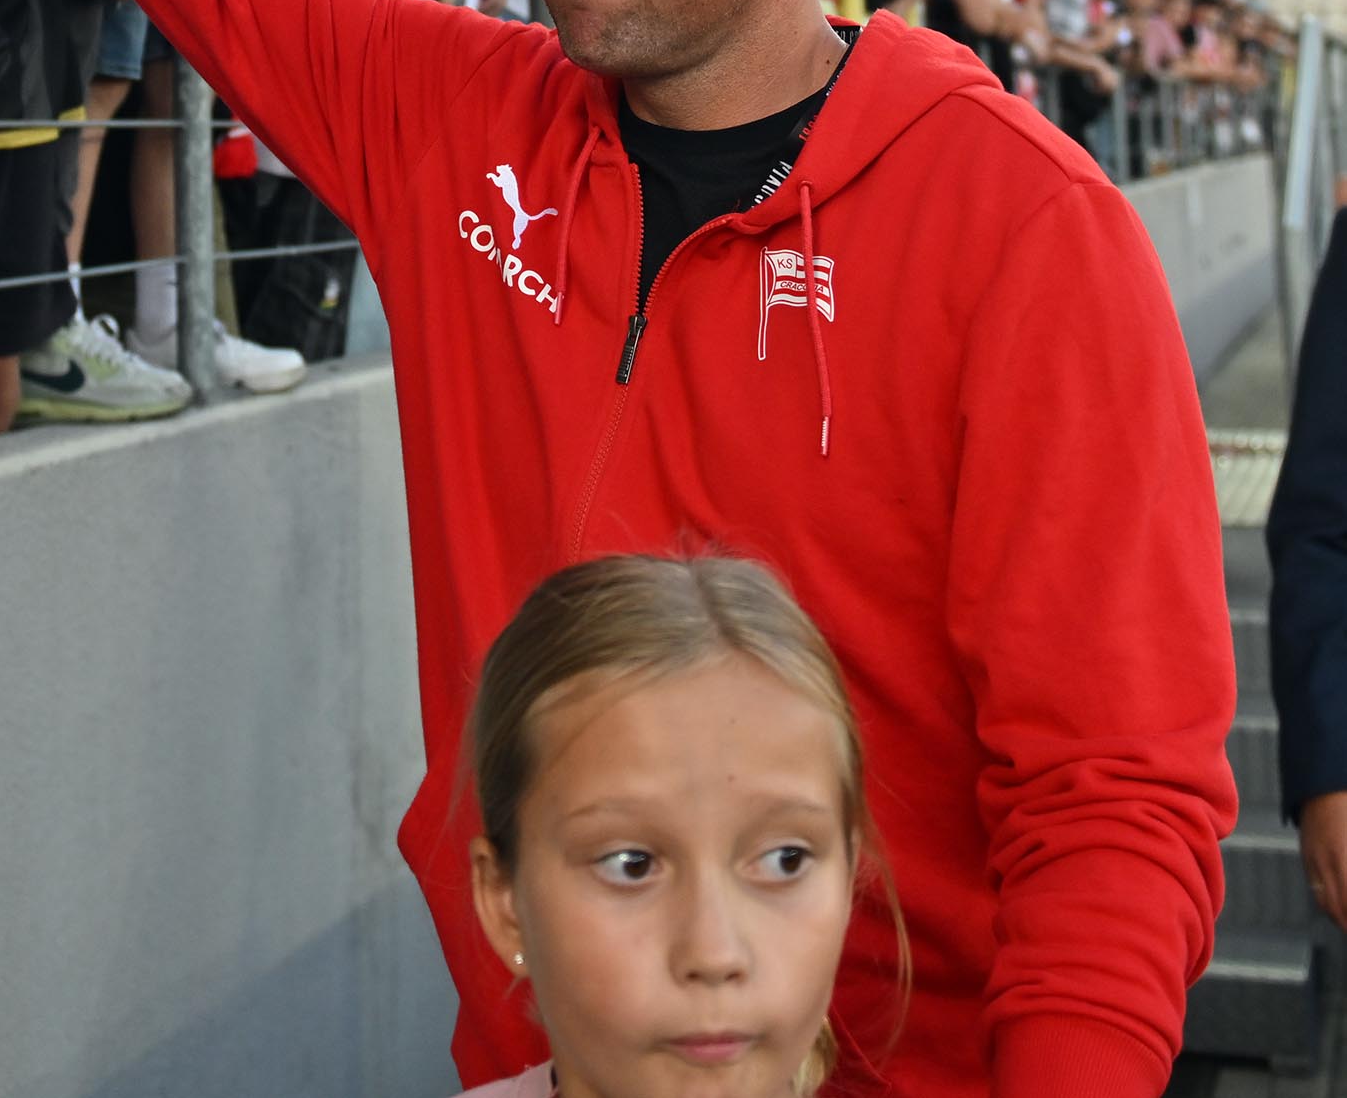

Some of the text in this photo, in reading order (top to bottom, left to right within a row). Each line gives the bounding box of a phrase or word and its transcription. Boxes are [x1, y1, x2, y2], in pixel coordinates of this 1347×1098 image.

[458, 210, 559, 314] CORCH
[777, 258, 794, 270] KS
[780, 281, 824, 293] CRACIA
